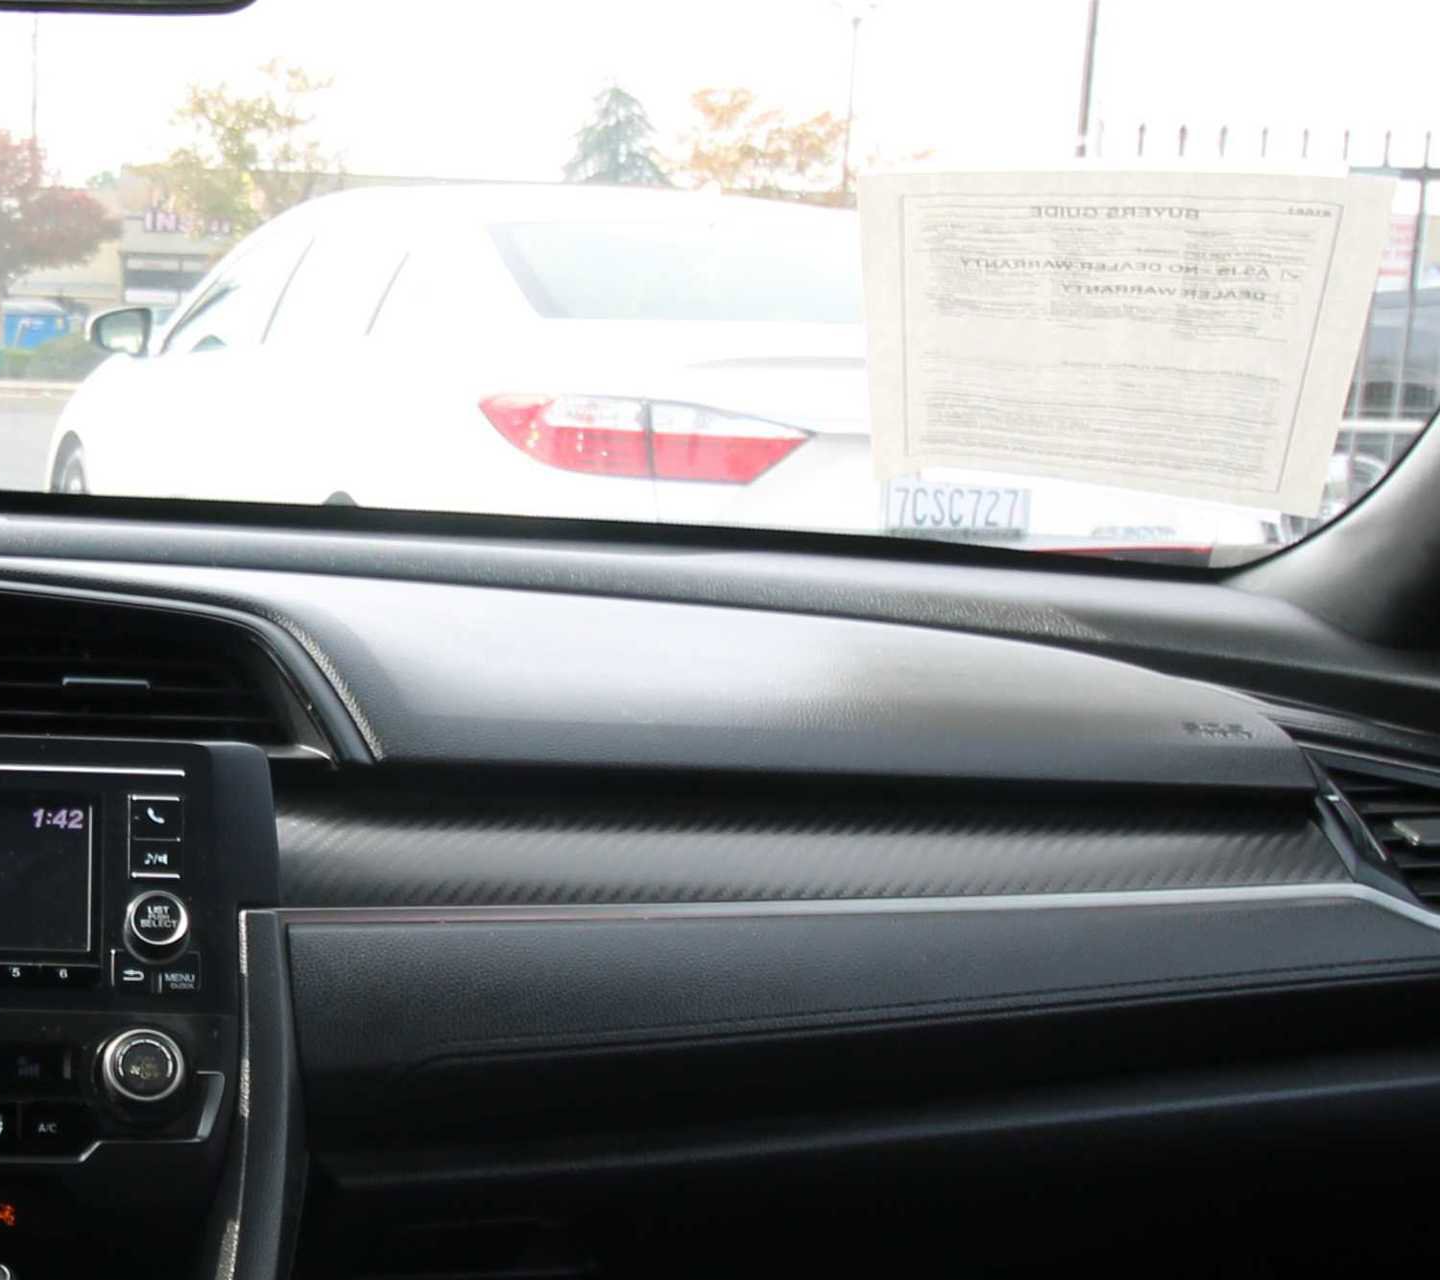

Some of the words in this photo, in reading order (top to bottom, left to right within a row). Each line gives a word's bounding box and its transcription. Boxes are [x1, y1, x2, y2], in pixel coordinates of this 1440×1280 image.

[894, 488, 1019, 528] 7CSC727
[32, 808, 84, 829] 1:42
[147, 905, 170, 914] LIST
[140, 919, 178, 928] SELECT
[11, 967, 21, 978] 5
[59, 968, 68, 978] 6
[164, 972, 195, 983] MENU
[37, 1123, 57, 1135] A/C
